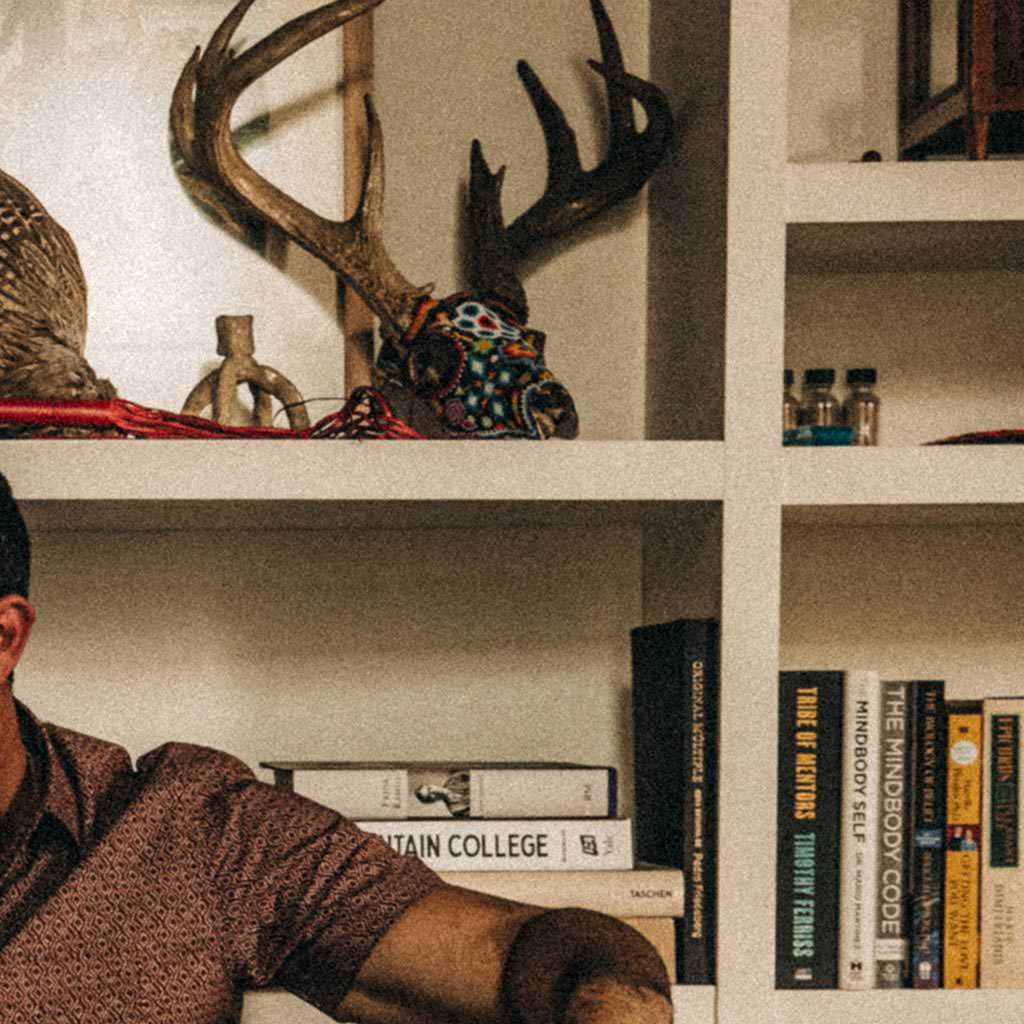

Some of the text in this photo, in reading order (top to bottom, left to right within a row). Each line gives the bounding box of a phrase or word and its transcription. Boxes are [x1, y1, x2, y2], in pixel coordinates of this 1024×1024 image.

[886, 686, 905, 731] THE
[794, 687, 818, 821] TRIBE OF MENTORS
[853, 700, 869, 796] MINDBODY
[852, 800, 867, 843] SELF
[882, 737, 904, 862] MINDBODY
[448, 833, 549, 858] COLLEGE
[629, 888, 673, 899] TASCHEN
[791, 832, 816, 959] TIMOTHY FERRISS
[880, 867, 901, 935] CODE
